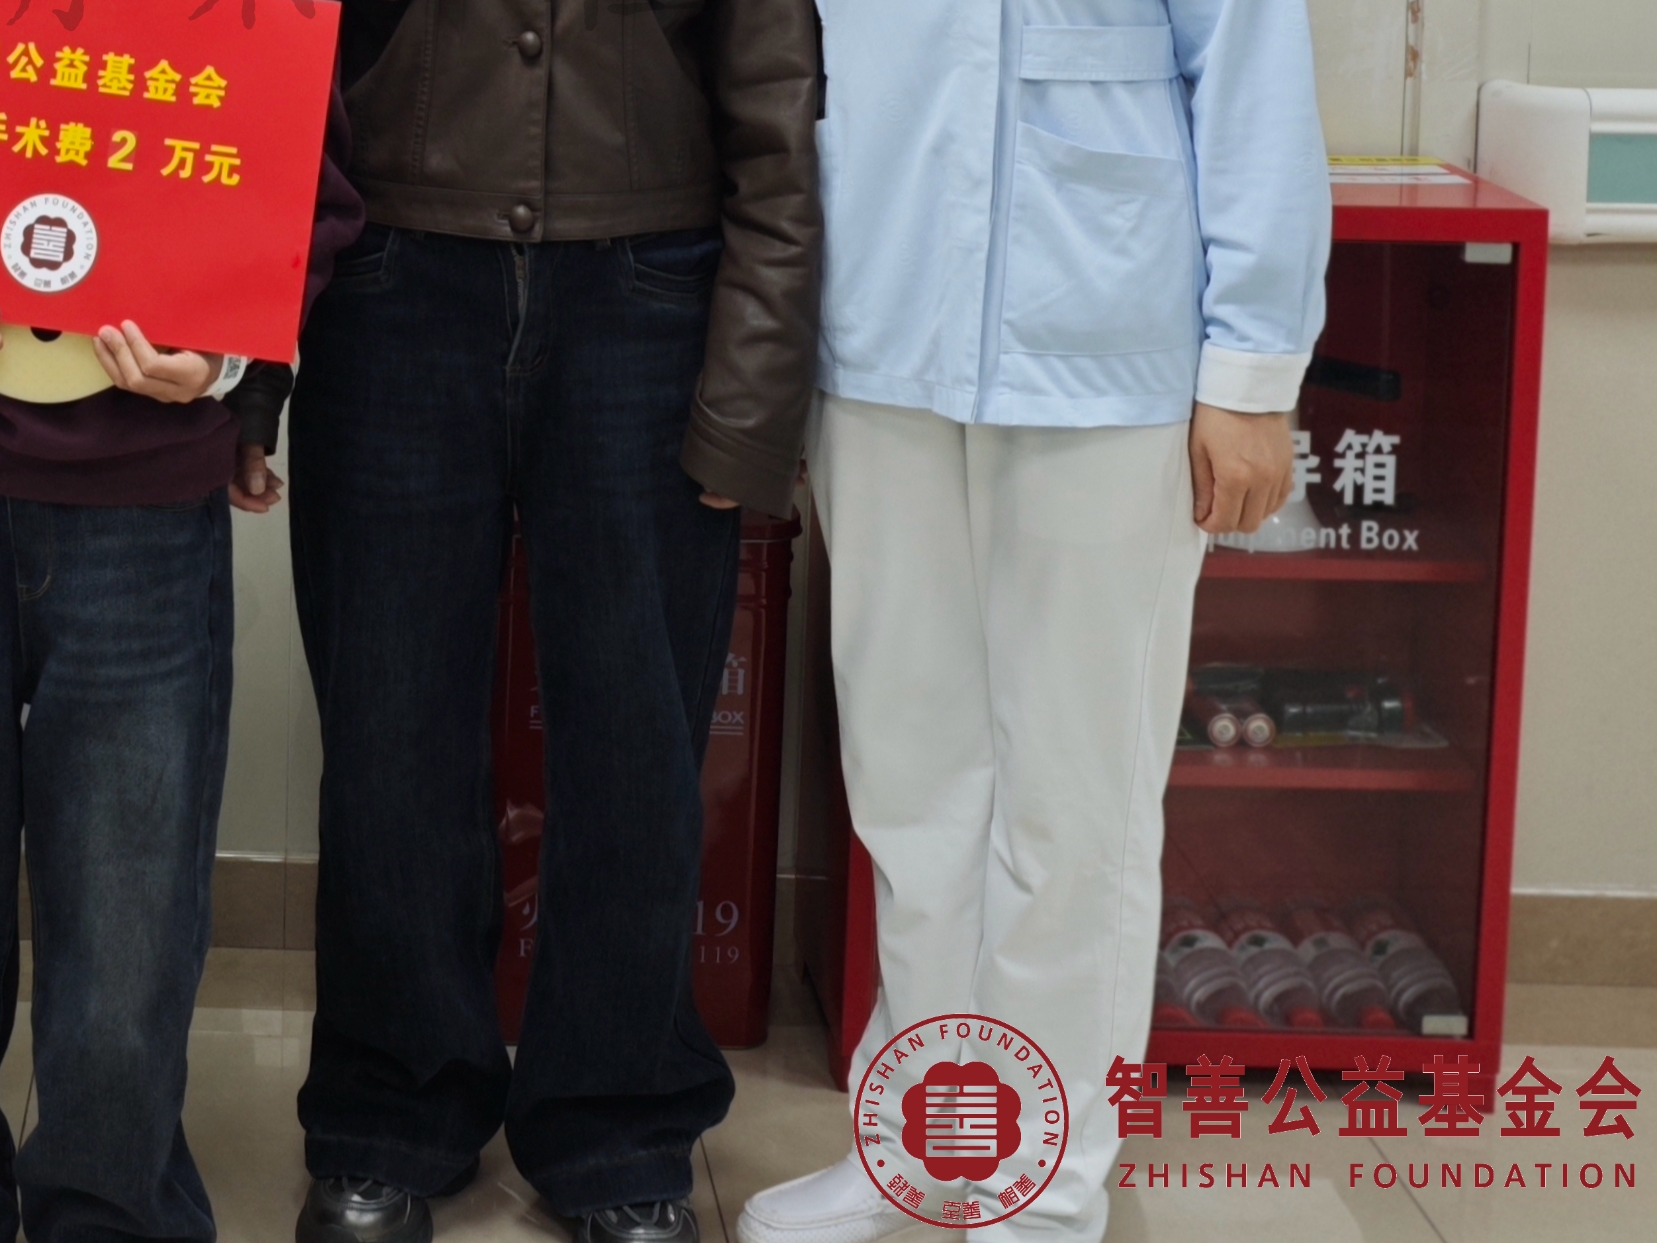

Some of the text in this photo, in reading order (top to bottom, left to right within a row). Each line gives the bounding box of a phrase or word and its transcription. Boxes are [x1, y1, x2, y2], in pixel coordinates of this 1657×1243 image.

[107, 129, 138, 171] 2
[160, 138, 242, 186] 万元
[3, 196, 95, 261] ZHISHAN FOUNDATION
[1360, 519, 1419, 551] Box
[699, 945, 740, 964] 119
